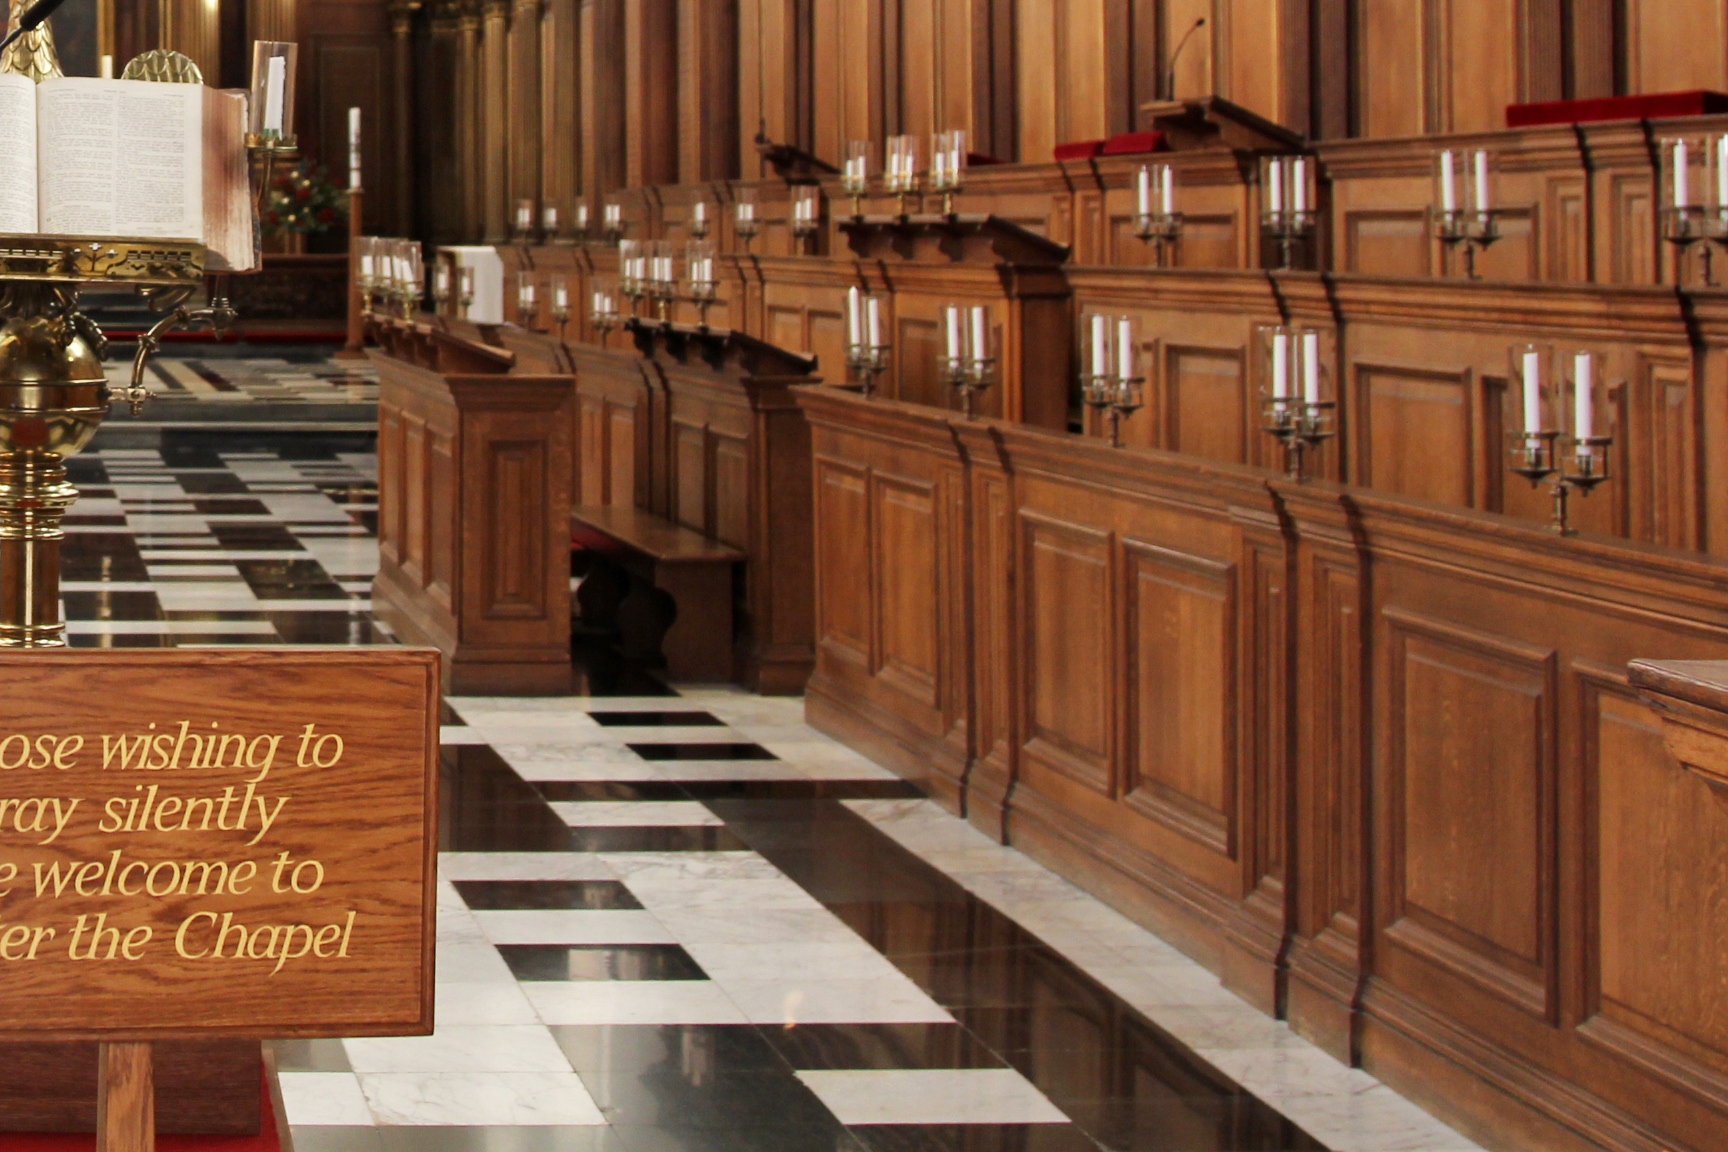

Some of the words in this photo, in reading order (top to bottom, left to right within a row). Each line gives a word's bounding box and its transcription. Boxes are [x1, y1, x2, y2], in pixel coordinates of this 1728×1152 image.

[99, 720, 284, 783] wishing
[296, 723, 344, 768] to
[98, 784, 290, 846] silently
[31, 849, 257, 899] welcome
[270, 850, 325, 894] to
[68, 912, 153, 961] the
[174, 910, 357, 976] Chapel
